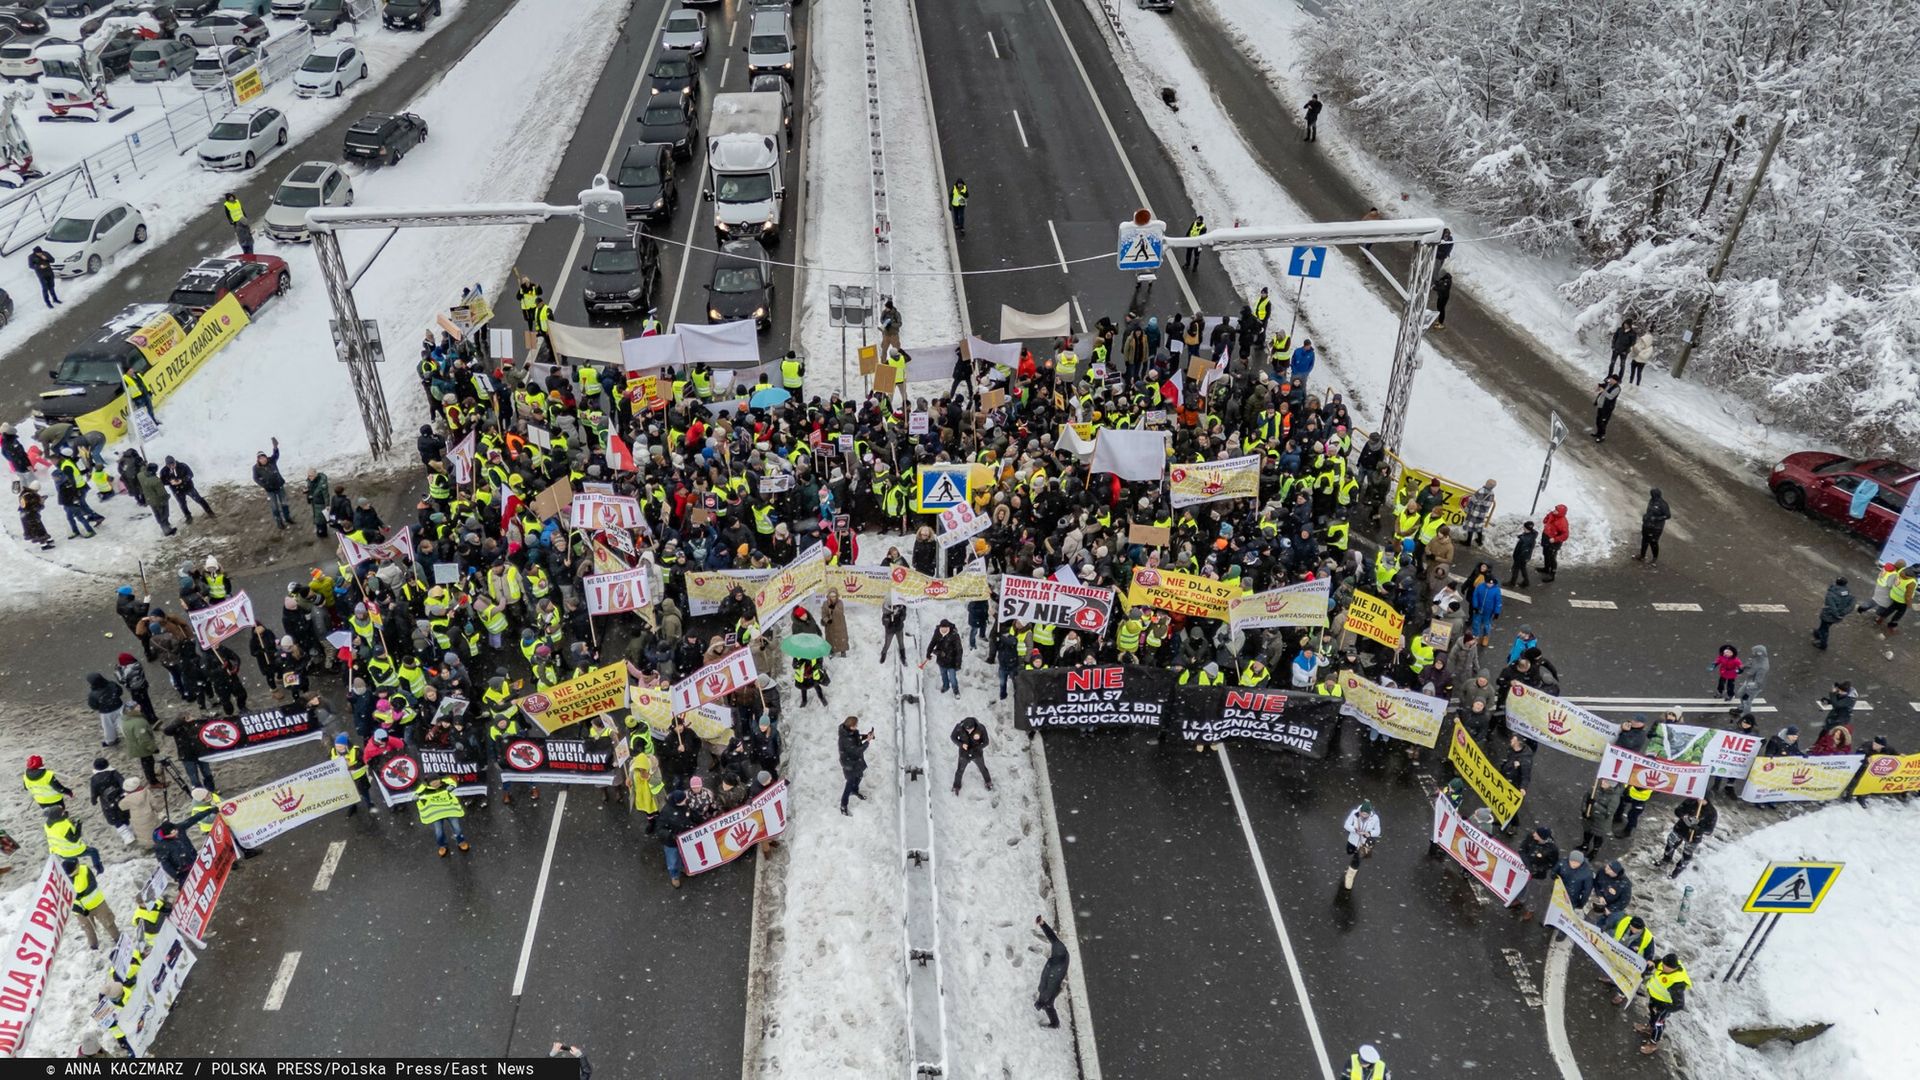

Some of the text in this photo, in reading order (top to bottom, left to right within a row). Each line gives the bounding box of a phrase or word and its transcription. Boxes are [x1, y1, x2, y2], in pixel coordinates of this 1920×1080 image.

[156, 372, 167, 392] S7
[166, 349, 190, 382] PRZEZ
[190, 318, 223, 360] KRAKÓW
[1004, 588, 1051, 603] ZOSTAJĄ
[1006, 577, 1110, 600] DOMY W ZAWADZIE
[1167, 577, 1232, 598] NIE DLA S7
[1003, 598, 1030, 618] S7
[1034, 602, 1072, 625] NIE
[1152, 597, 1208, 616] RAZEM
[1351, 608, 1375, 623] PRZEZ
[1352, 595, 1404, 629] NIE DLA S7
[1081, 619, 1097, 627] STOP
[553, 670, 617, 699] NIE DLA S7
[683, 679, 692, 687] DLA
[699, 666, 714, 677] PRZEZ
[1066, 667, 1124, 691] NIE
[528, 696, 538, 705] S7
[546, 686, 625, 718] PROTESTUJEMY
[557, 678, 624, 705] PRZEZ POŁUDNIE
[1067, 690, 1123, 703] DLA S7
[1225, 690, 1288, 713] NIE
[1540, 696, 1550, 704] dla
[240, 710, 283, 726] GMINA
[558, 697, 616, 724] RAZEM
[1027, 702, 1162, 716] I ŁĄCZNIKA Z BDI
[1224, 709, 1281, 722] DLA S7
[244, 713, 309, 735] MOGILANY
[1029, 714, 1160, 727] W GŁOGOCZOWIE
[1182, 719, 1318, 740] I ŁĄCZNIKA Z BDI
[1582, 720, 1617, 737] KRAKOWA
[546, 742, 585, 754] GMINA
[1182, 728, 1313, 752] W GŁOGOCZOWIE
[1722, 735, 1756, 753] NIE
[421, 752, 456, 764] GMINA
[422, 762, 478, 774] MOGILANY
[548, 752, 607, 764] MOGILANY
[1453, 747, 1474, 780] PRZEZ
[1610, 747, 1618, 756] NIE
[1621, 752, 1632, 760] DLA
[1642, 759, 1660, 769] PRZEZ
[253, 790, 265, 798] dla
[300, 762, 336, 778] POŁUDNIE
[1466, 743, 1521, 806] NIE DLA S7
[1882, 782, 1920, 791] RAZ
[280, 800, 298, 812] STOP
[681, 783, 786, 844] NIE DLA S7 PRZEZ KRZYSZKOWICE
[256, 828, 267, 836] dla
[279, 812, 299, 824] przez
[1462, 822, 1527, 873] PRZEZ KRZYSZKOWICE
[169, 894, 187, 926] NIE
[184, 862, 204, 900] DLA
[201, 836, 217, 870] S7
[30, 861, 64, 932] PRZEZ
[197, 878, 217, 914] BDI
[16, 932, 47, 966] S7
[0, 970, 37, 1013] DLA
[0, 1020, 23, 1055] NIE
